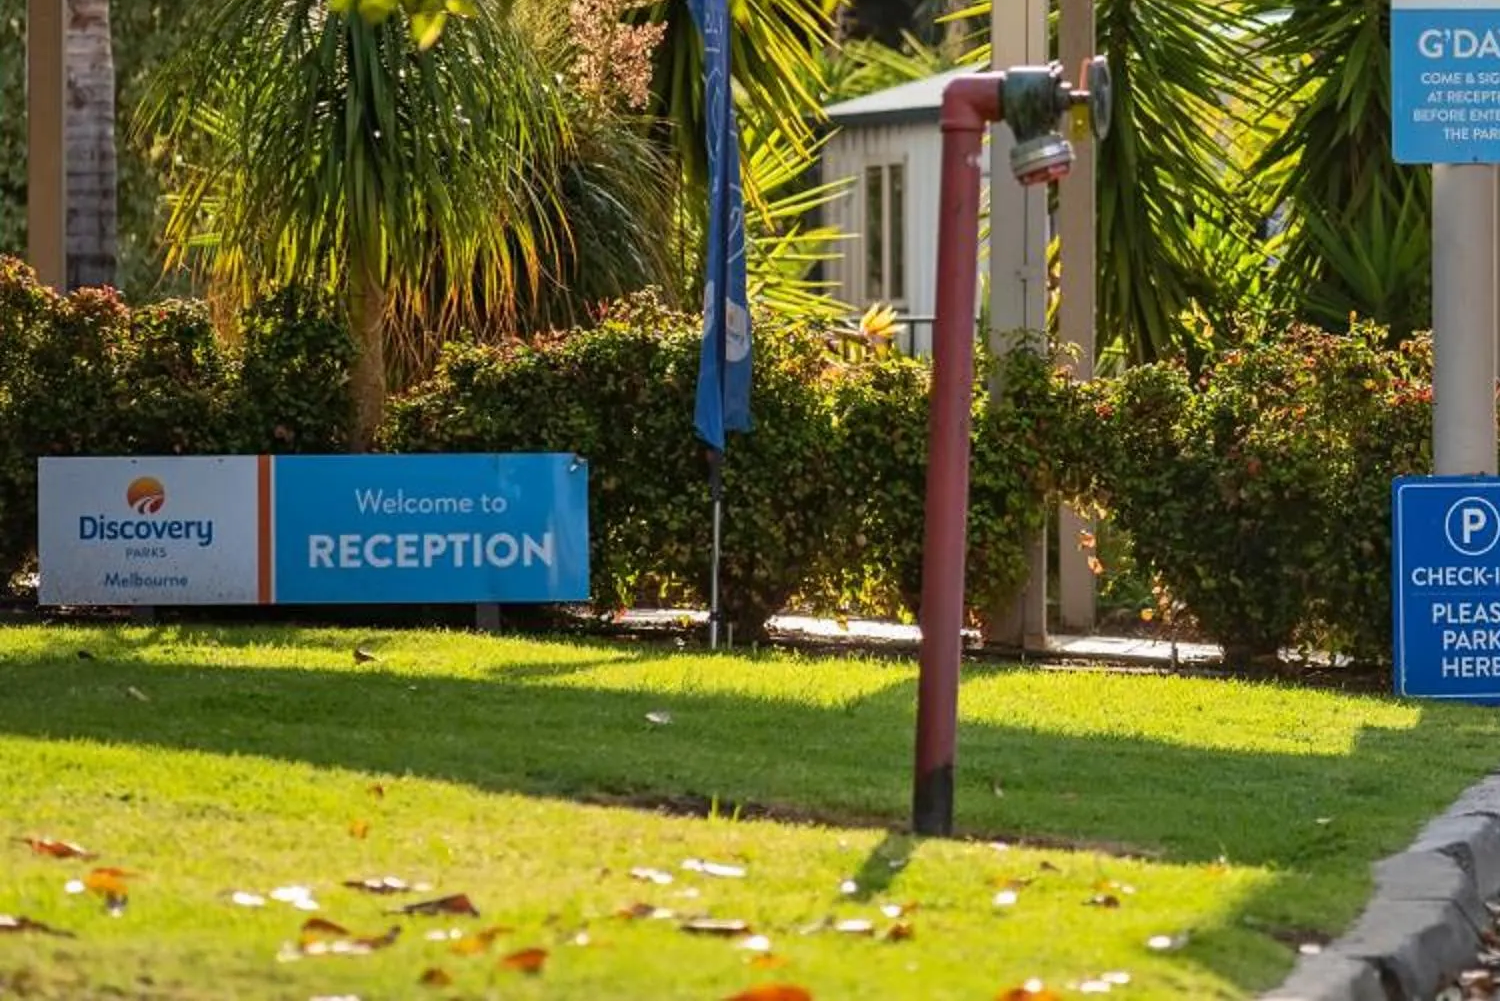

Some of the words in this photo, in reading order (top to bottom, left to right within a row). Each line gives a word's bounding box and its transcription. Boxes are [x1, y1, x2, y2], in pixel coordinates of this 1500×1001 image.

[1420, 72, 1461, 85] COME
[1465, 72, 1476, 85] &
[1427, 90, 1443, 103] AT
[1413, 108, 1467, 122] BEFORE
[1443, 127, 1469, 141] THE
[355, 487, 473, 514] Welcome
[481, 493, 508, 514] to
[79, 514, 214, 548] Discovery
[1462, 508, 1487, 544] P
[124, 546, 168, 559] PARKS
[308, 532, 555, 568] RECEPTION
[103, 571, 189, 588] Melbourne
